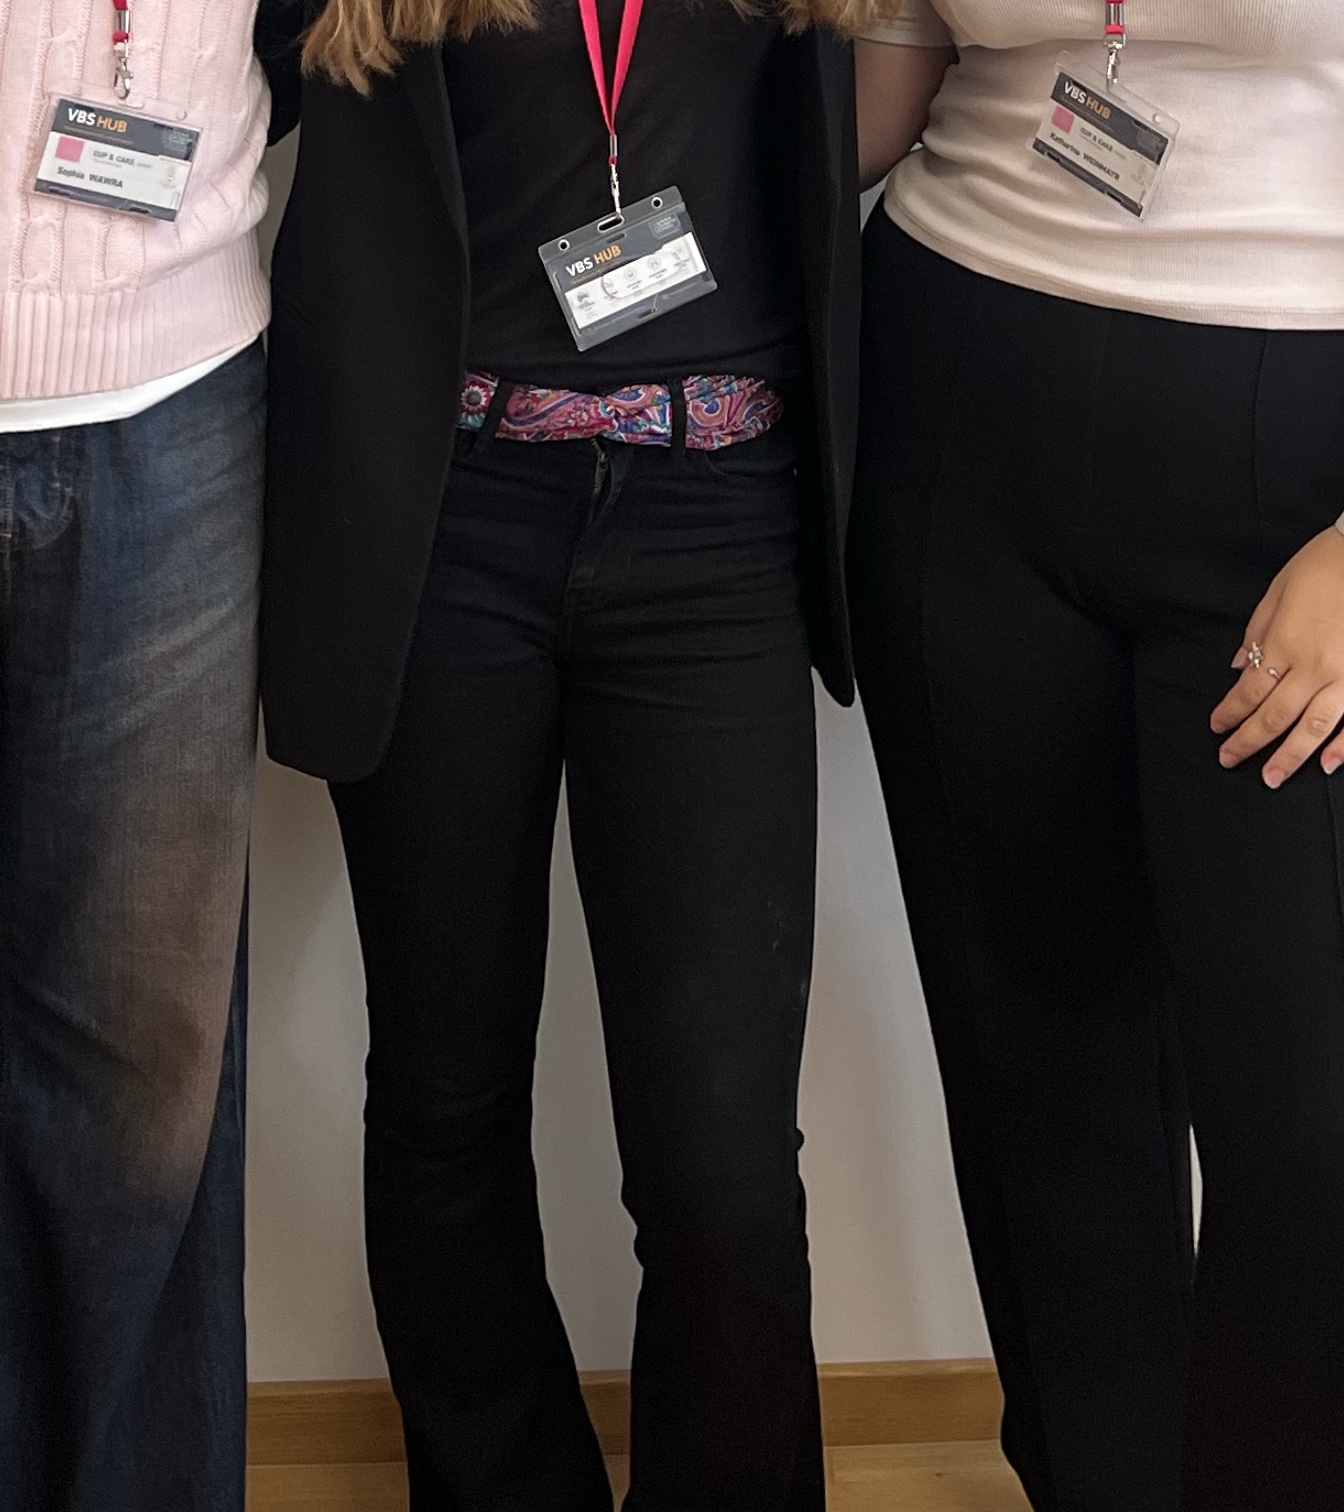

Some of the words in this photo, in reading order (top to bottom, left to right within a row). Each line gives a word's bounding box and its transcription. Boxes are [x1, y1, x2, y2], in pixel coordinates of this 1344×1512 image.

[1063, 80, 1087, 104] VBS
[1085, 96, 1112, 120] HUB
[67, 107, 96, 126] VBS
[97, 115, 128, 133] HUB
[565, 256, 594, 277] VBS
[593, 243, 622, 265] HUB
